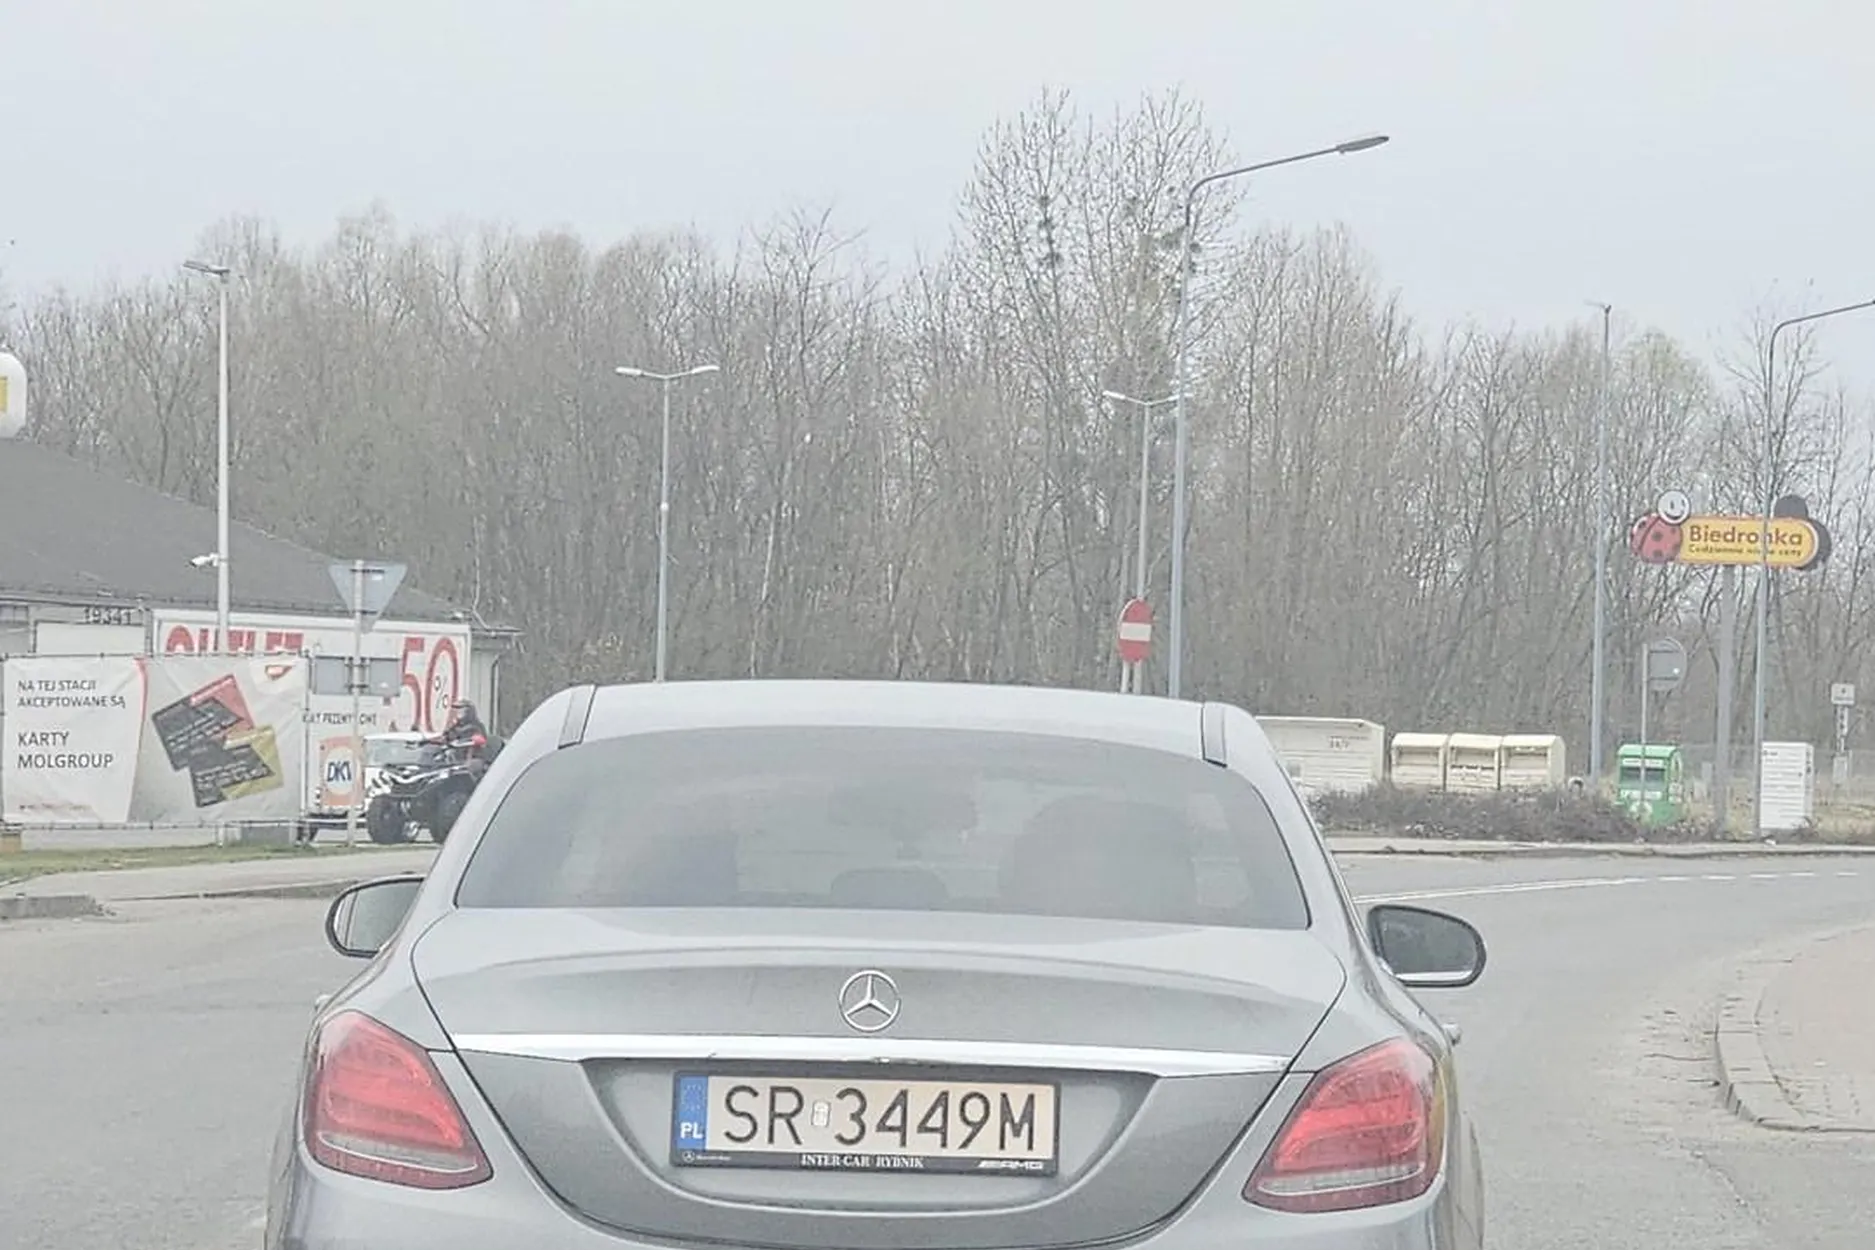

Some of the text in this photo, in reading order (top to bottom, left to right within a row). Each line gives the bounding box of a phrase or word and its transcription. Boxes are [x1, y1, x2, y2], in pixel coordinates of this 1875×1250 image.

[1690, 525, 1802, 545] Biedronka
[18, 680, 97, 692] NA TEJ STACJI
[17, 695, 126, 709] AKCEPTOWANE SĄ
[18, 731, 70, 747] KARTY
[18, 754, 114, 769] MOLGROUP
[724, 1085, 1035, 1152] SR 3449M
[680, 1122, 704, 1139] PL
